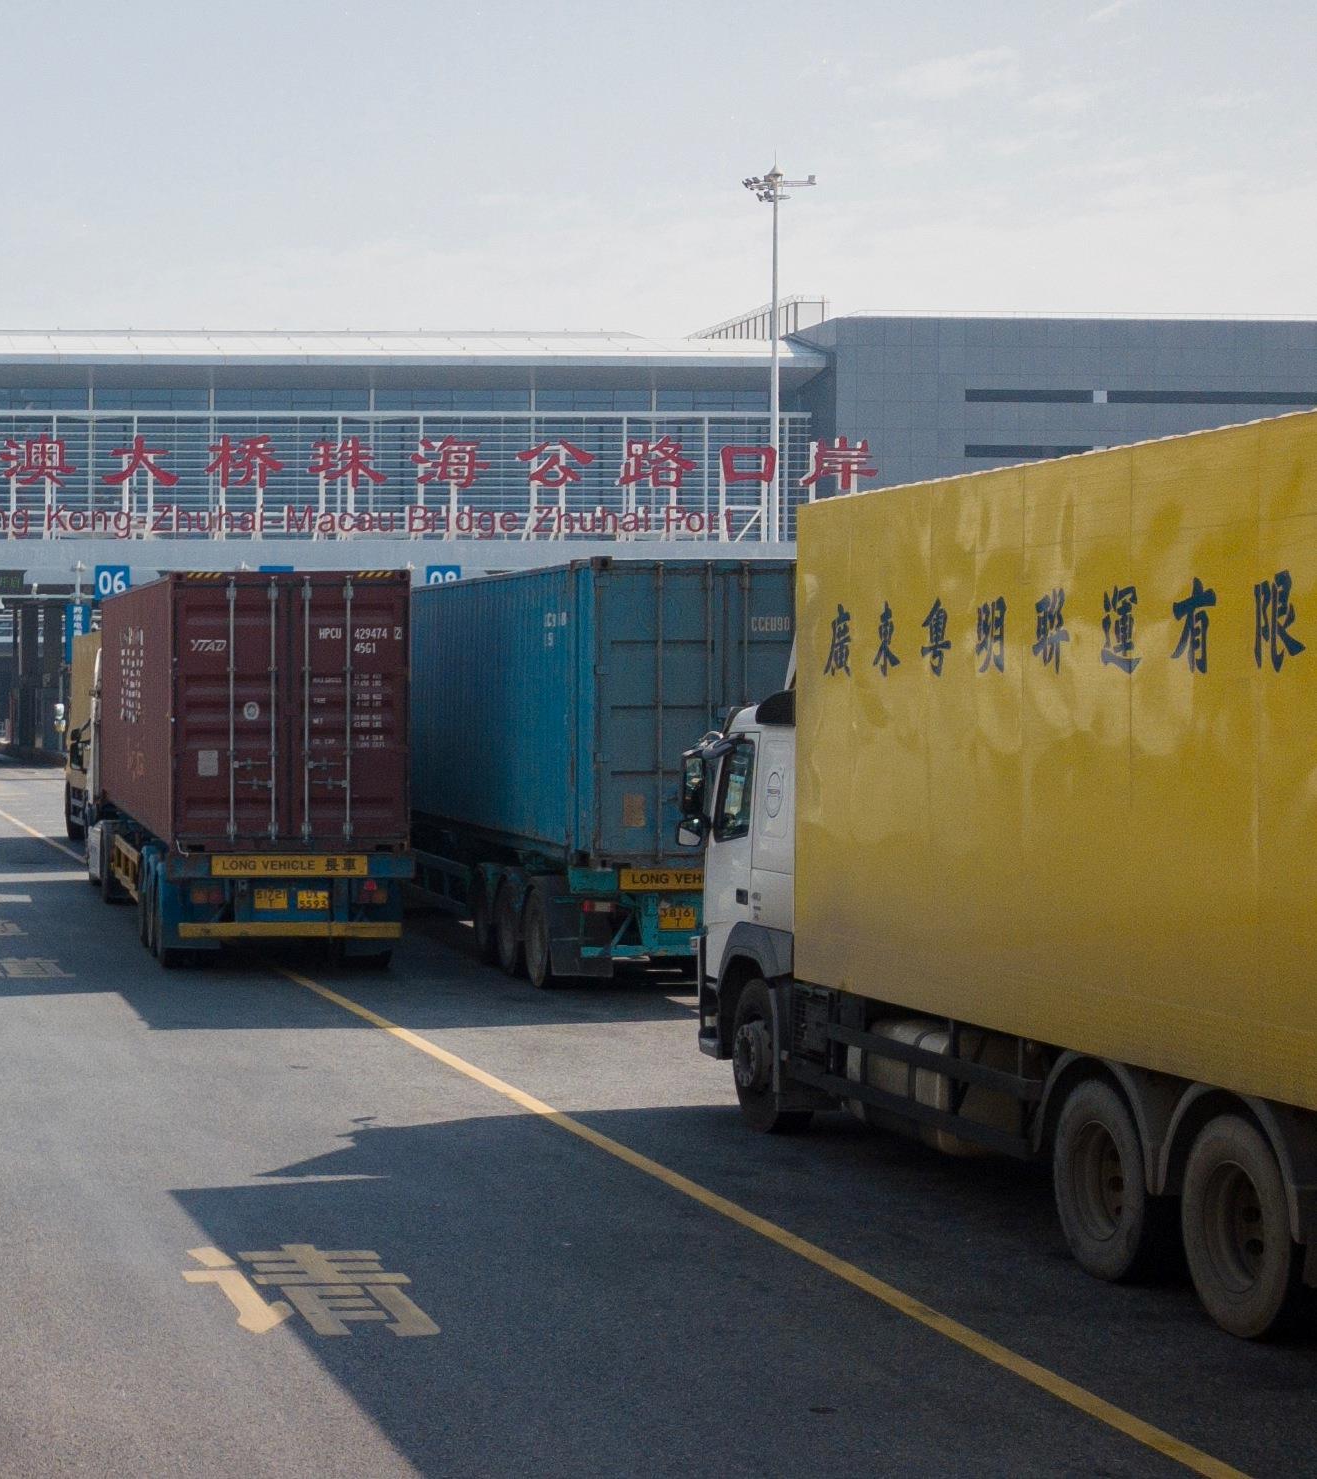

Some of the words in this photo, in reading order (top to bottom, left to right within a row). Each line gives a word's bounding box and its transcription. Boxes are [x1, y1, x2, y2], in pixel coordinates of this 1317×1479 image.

[409, 505, 518, 539] Bridge
[532, 505, 651, 533] Zhuhai
[665, 505, 735, 533] Port
[98, 571, 126, 593] 06
[354, 627, 388, 640] 429474
[394, 627, 403, 640] 2
[354, 642, 377, 654] 45G1
[222, 860, 257, 872] LONG
[261, 860, 316, 872] VEHICLE
[324, 857, 357, 872] 長車
[631, 873, 670, 885] LONG
[181, 1244, 442, 1338] 请
